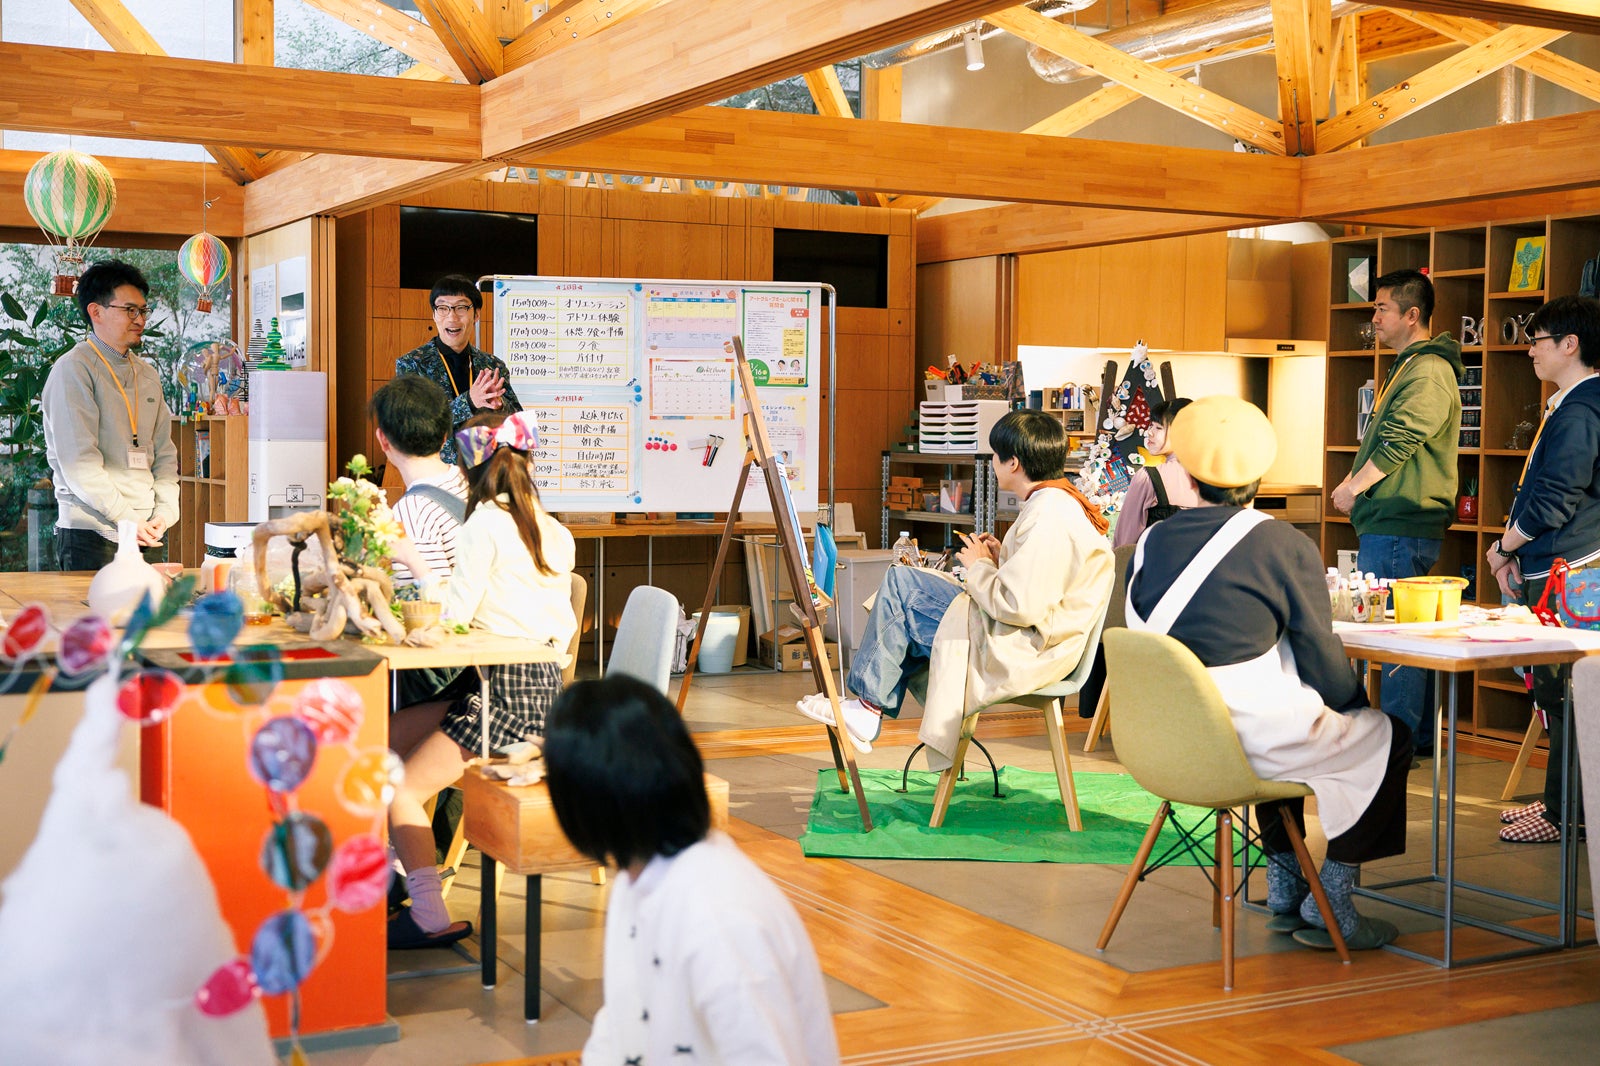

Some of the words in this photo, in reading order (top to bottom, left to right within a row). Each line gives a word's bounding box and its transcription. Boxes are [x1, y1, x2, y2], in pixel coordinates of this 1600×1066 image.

[564, 298, 626, 309] オリエンテーション
[566, 312, 620, 323] アトリエ体験
[578, 340, 600, 351] 夕食
[576, 352, 604, 364] 片付け
[572, 423, 617, 434] 朝食の準備
[581, 436, 604, 447] 朝食
[577, 451, 615, 461] 自由時間
